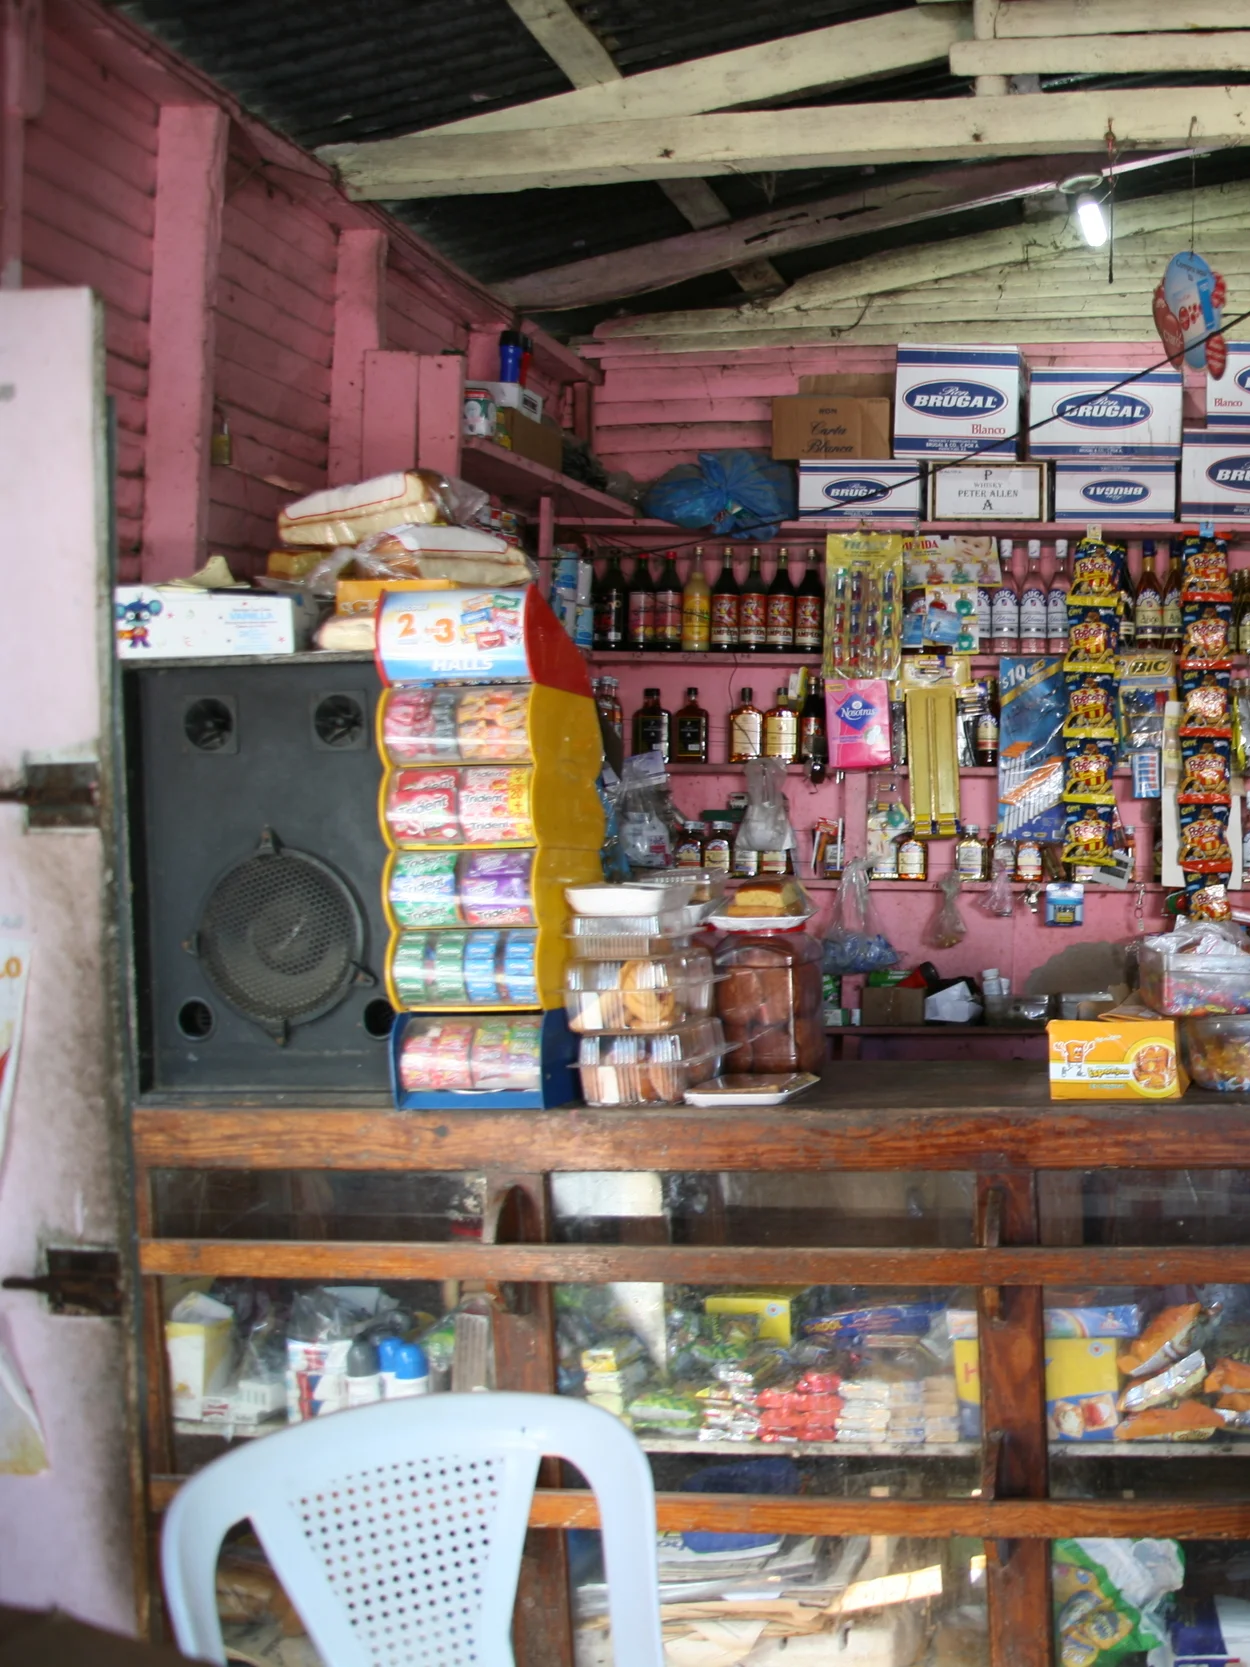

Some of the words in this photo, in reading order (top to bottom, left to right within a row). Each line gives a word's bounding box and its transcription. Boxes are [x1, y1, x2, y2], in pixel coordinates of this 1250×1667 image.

[913, 394, 997, 408] BRUGAL
[1214, 398, 1242, 407] Blanco
[1063, 404, 1143, 418] BRUGAL
[810, 421, 848, 436] Carta
[971, 424, 1006, 435] Blanco
[801, 439, 854, 454] Blanca
[984, 469, 993, 481] P
[957, 490, 987, 498] PETER
[990, 490, 1019, 498] ALLEN
[1088, 486, 1144, 496] BRUGAL
[982, 499, 994, 511] A
[397, 613, 417, 638] 2
[434, 618, 456, 644] 3
[431, 658, 493, 672] HALLS
[1131, 660, 1167, 672] BIC
[841, 707, 876, 718] Nosotras
[464, 794, 504, 803] Trident
